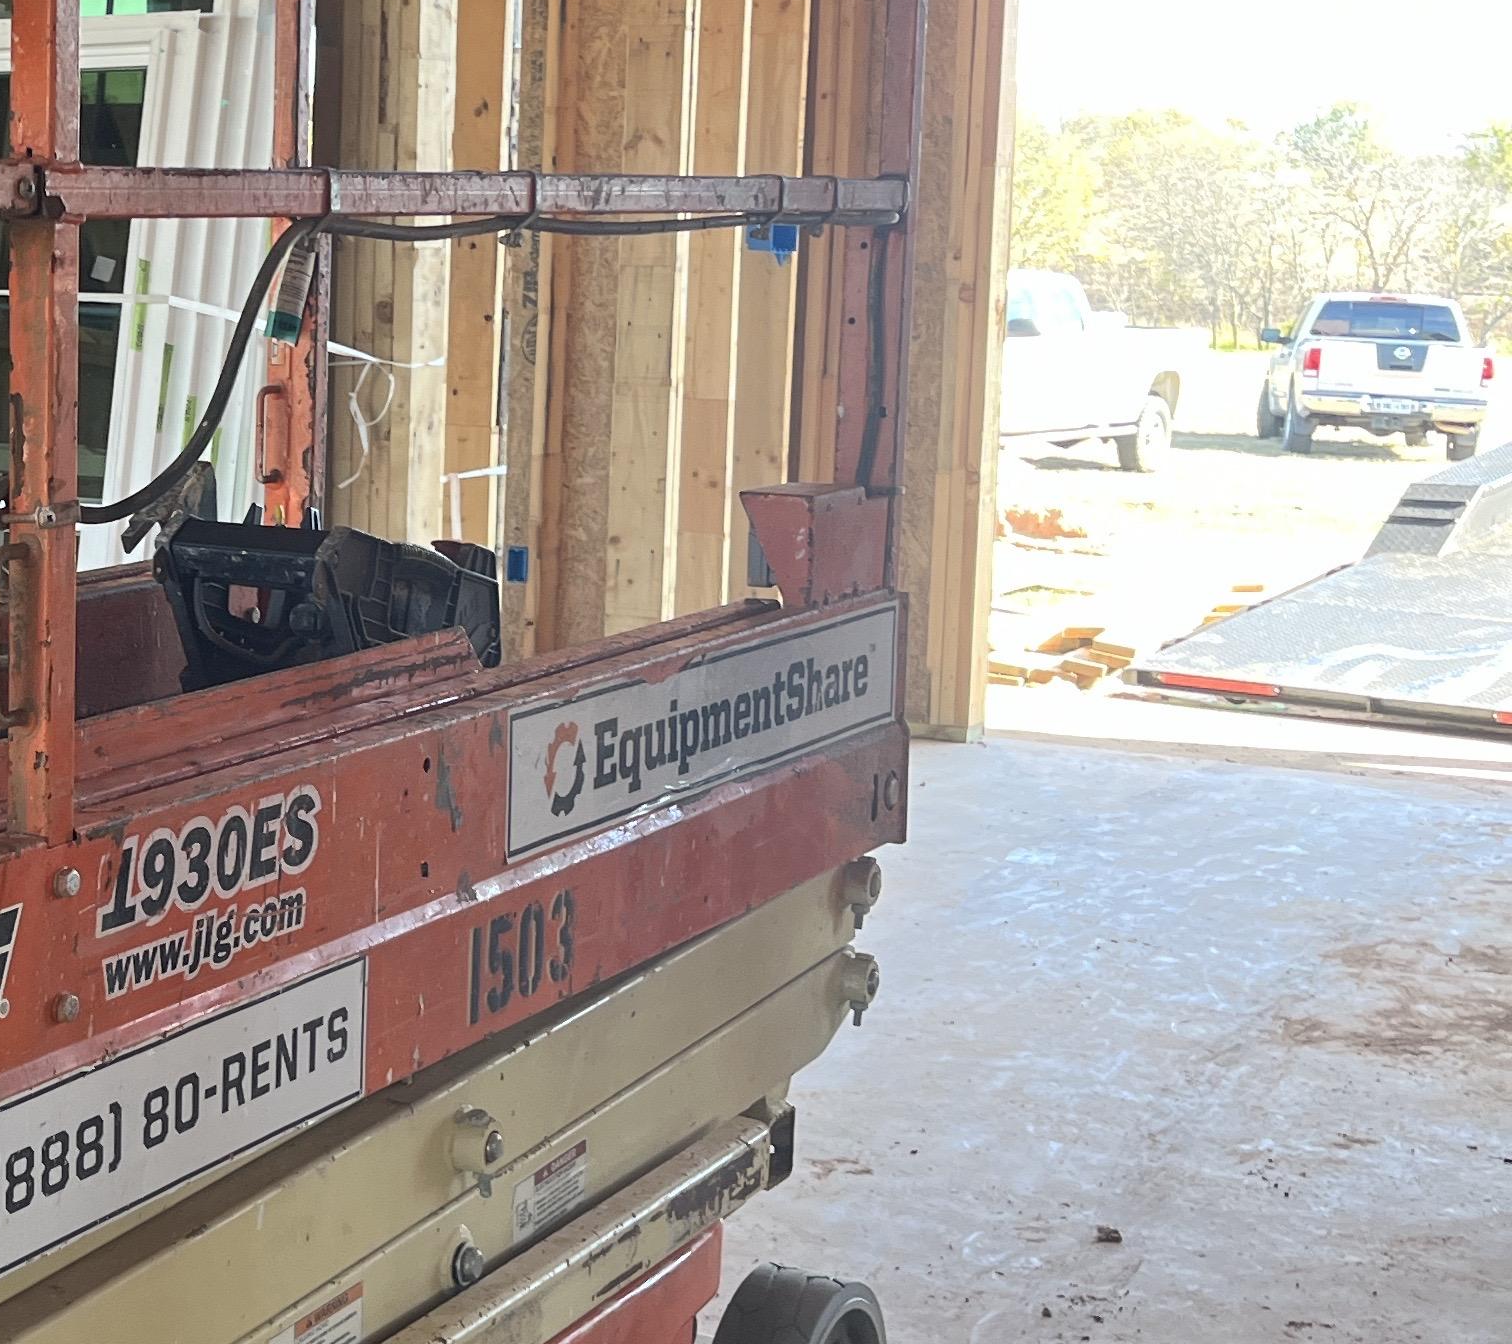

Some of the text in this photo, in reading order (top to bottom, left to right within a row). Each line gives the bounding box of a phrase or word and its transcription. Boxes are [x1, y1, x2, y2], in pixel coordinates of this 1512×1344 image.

[593, 655, 870, 793] EquipmentShare
[98, 787, 319, 935] 1930ES
[103, 890, 305, 997] www.jlg.com
[467, 887, 575, 1025] 1503
[142, 1005, 350, 1150] 80-RENTS
